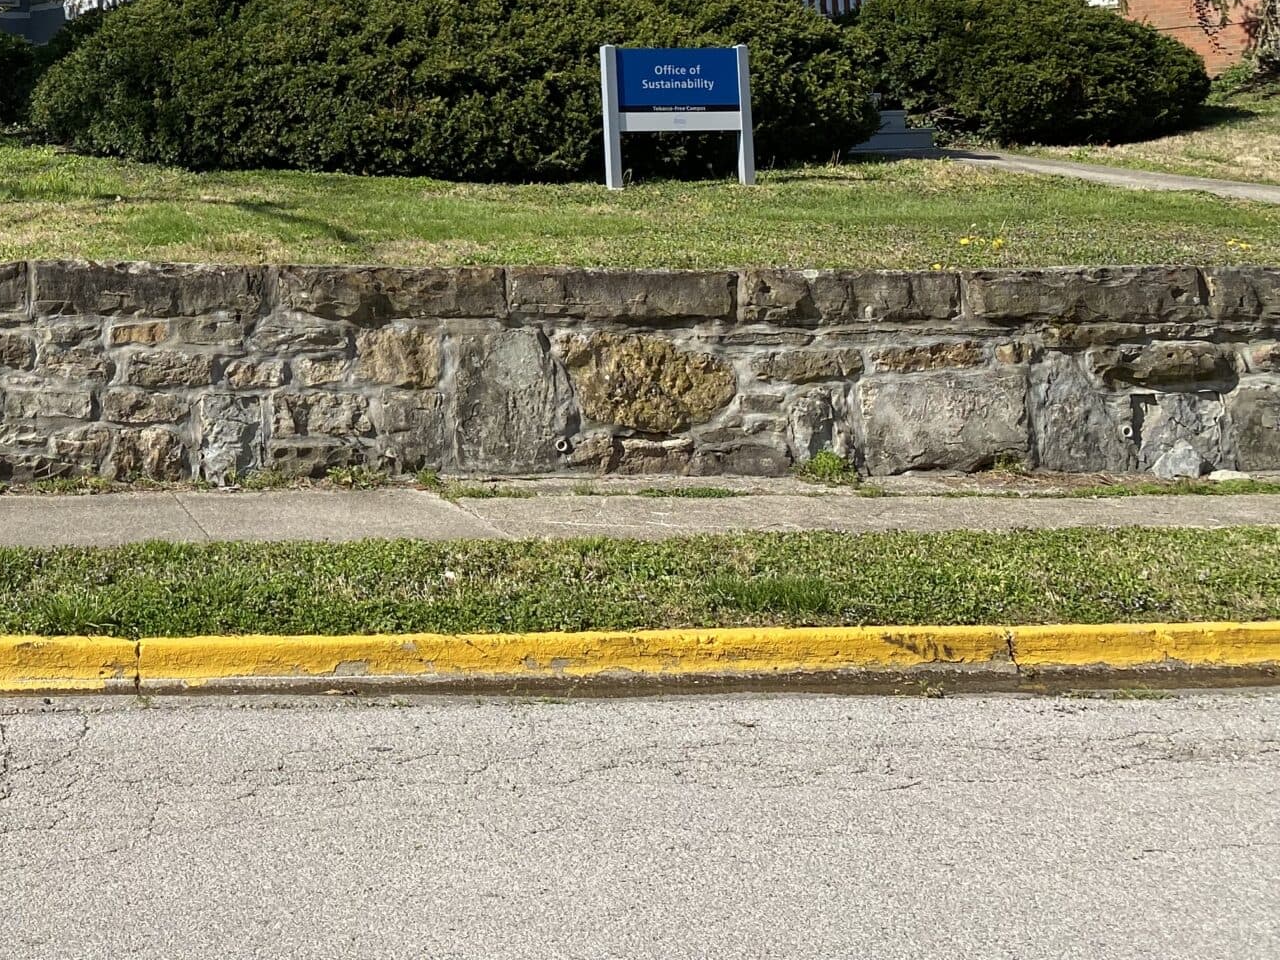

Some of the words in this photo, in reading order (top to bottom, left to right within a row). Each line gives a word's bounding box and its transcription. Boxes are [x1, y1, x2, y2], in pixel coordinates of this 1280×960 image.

[654, 64, 686, 75] Office
[689, 64, 701, 75] of
[642, 78, 714, 91] Sustainability
